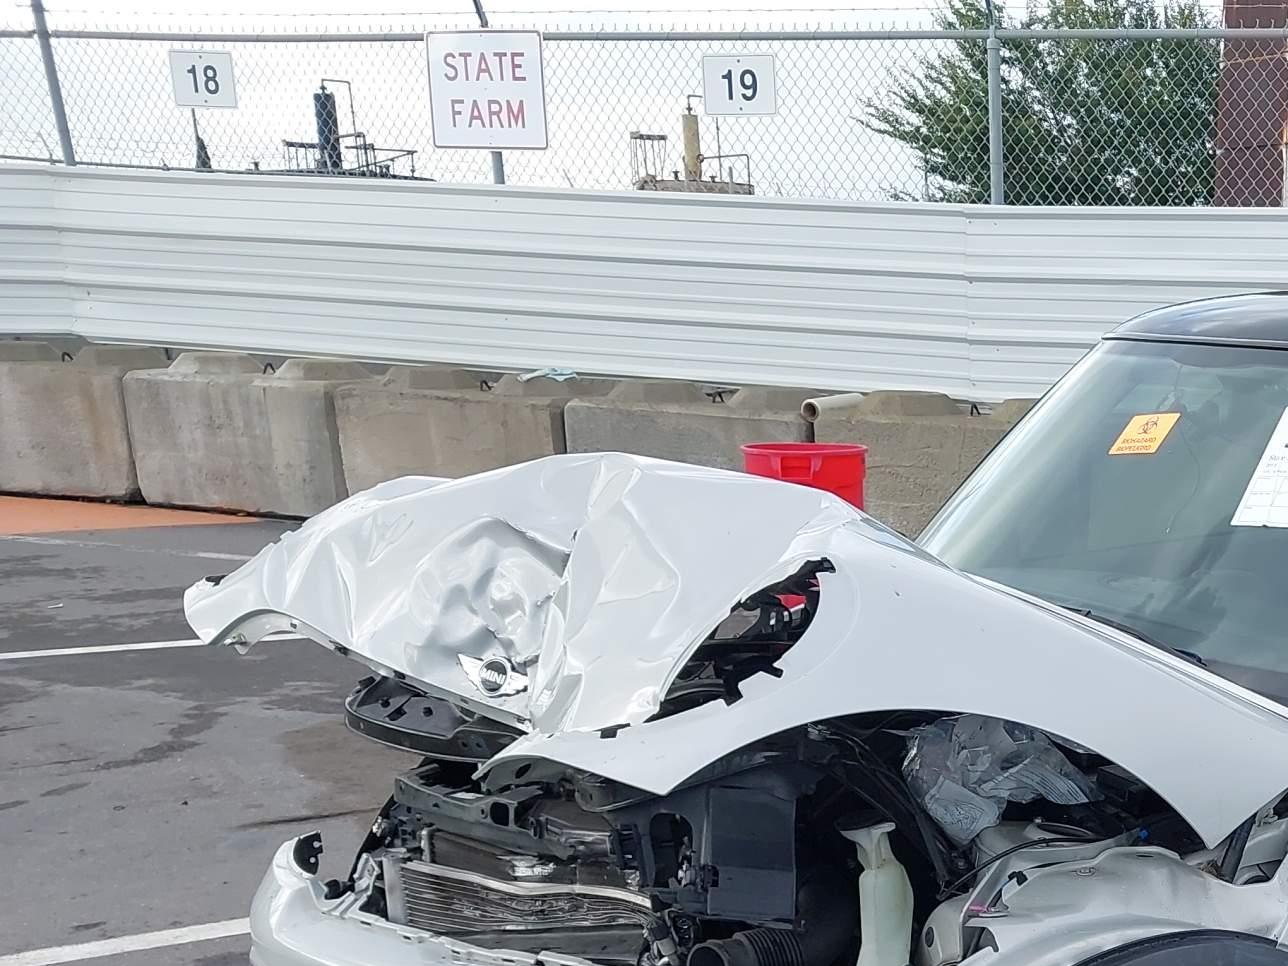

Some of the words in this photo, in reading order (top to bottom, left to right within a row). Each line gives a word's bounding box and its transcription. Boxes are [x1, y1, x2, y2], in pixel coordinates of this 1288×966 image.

[187, 64, 219, 95] 18
[443, 52, 527, 81] STATE
[721, 69, 757, 101] 19
[450, 99, 526, 129] FARM
[480, 667, 506, 685] MINI
